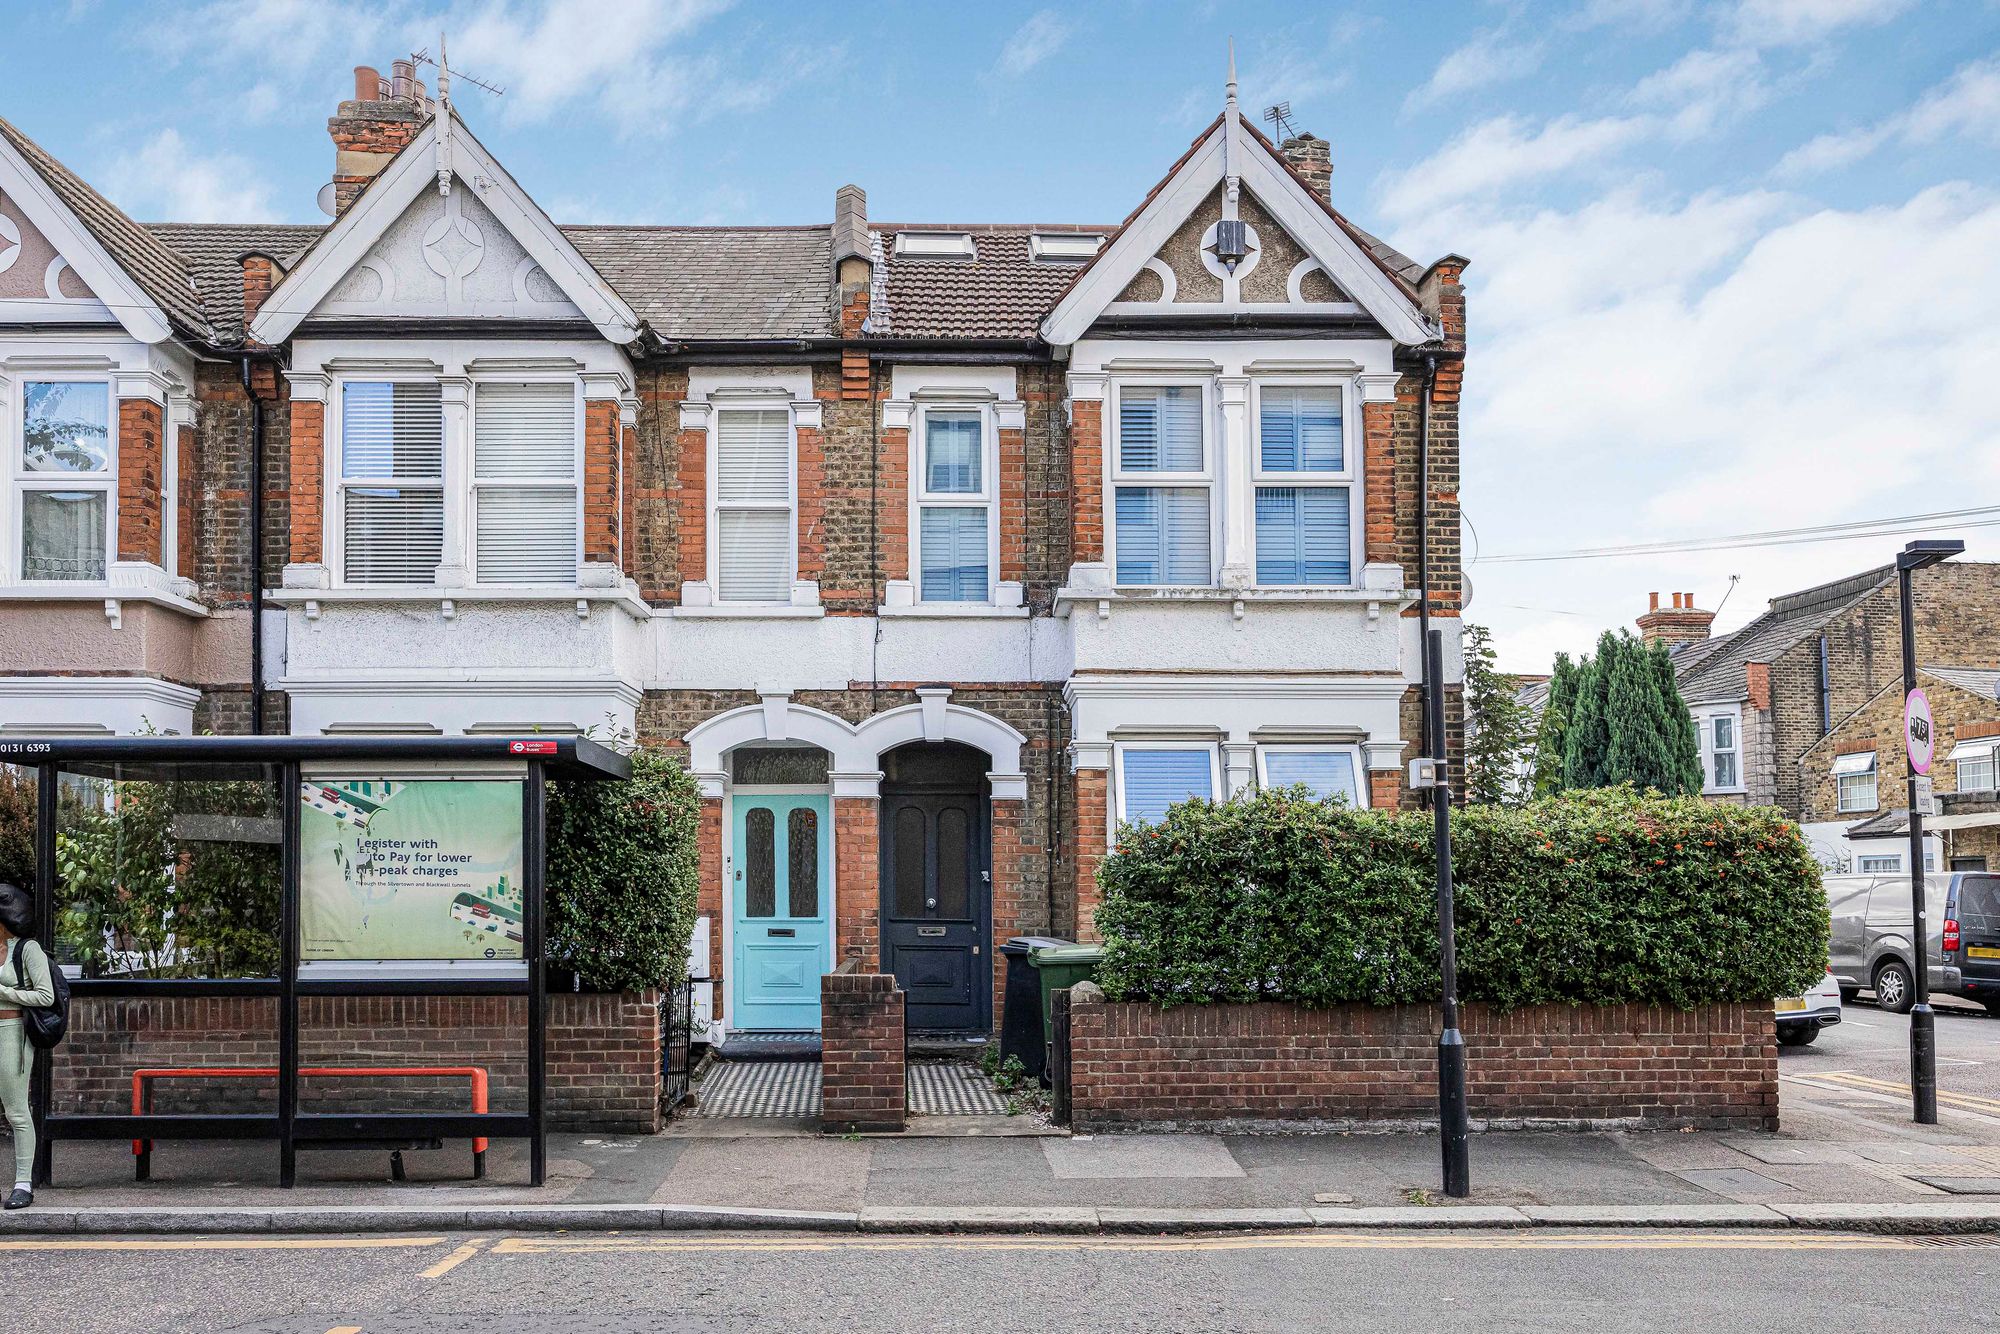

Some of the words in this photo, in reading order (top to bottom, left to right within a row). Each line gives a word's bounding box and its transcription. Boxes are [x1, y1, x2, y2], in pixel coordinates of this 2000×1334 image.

[0, 743, 23, 753] 0131
[26, 743, 51, 753] 6393
[409, 839, 438, 849] with
[390, 851, 411, 864] Pay
[415, 852, 433, 862] for
[437, 852, 473, 863] lower
[356, 865, 408, 877] -peak
[412, 866, 458, 878] charges
